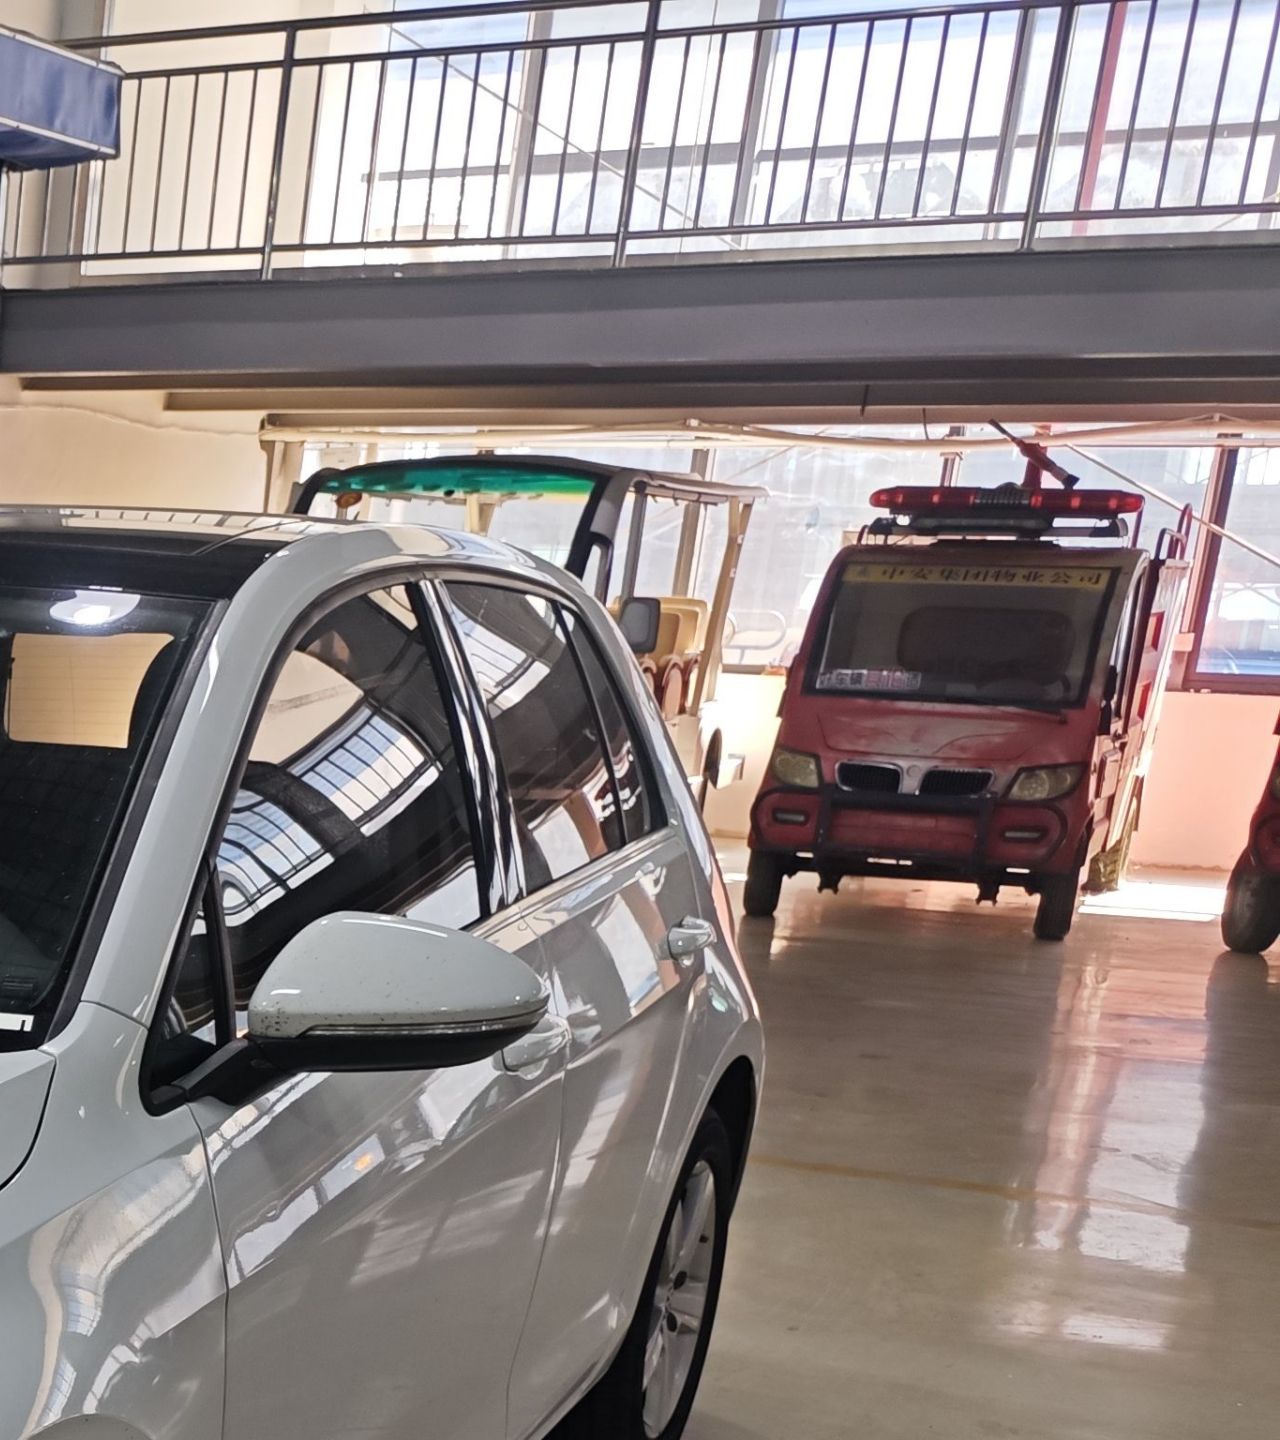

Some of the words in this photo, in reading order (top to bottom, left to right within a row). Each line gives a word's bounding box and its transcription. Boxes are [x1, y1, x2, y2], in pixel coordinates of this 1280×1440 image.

[881, 567, 1104, 586] 中安集团物业公司
